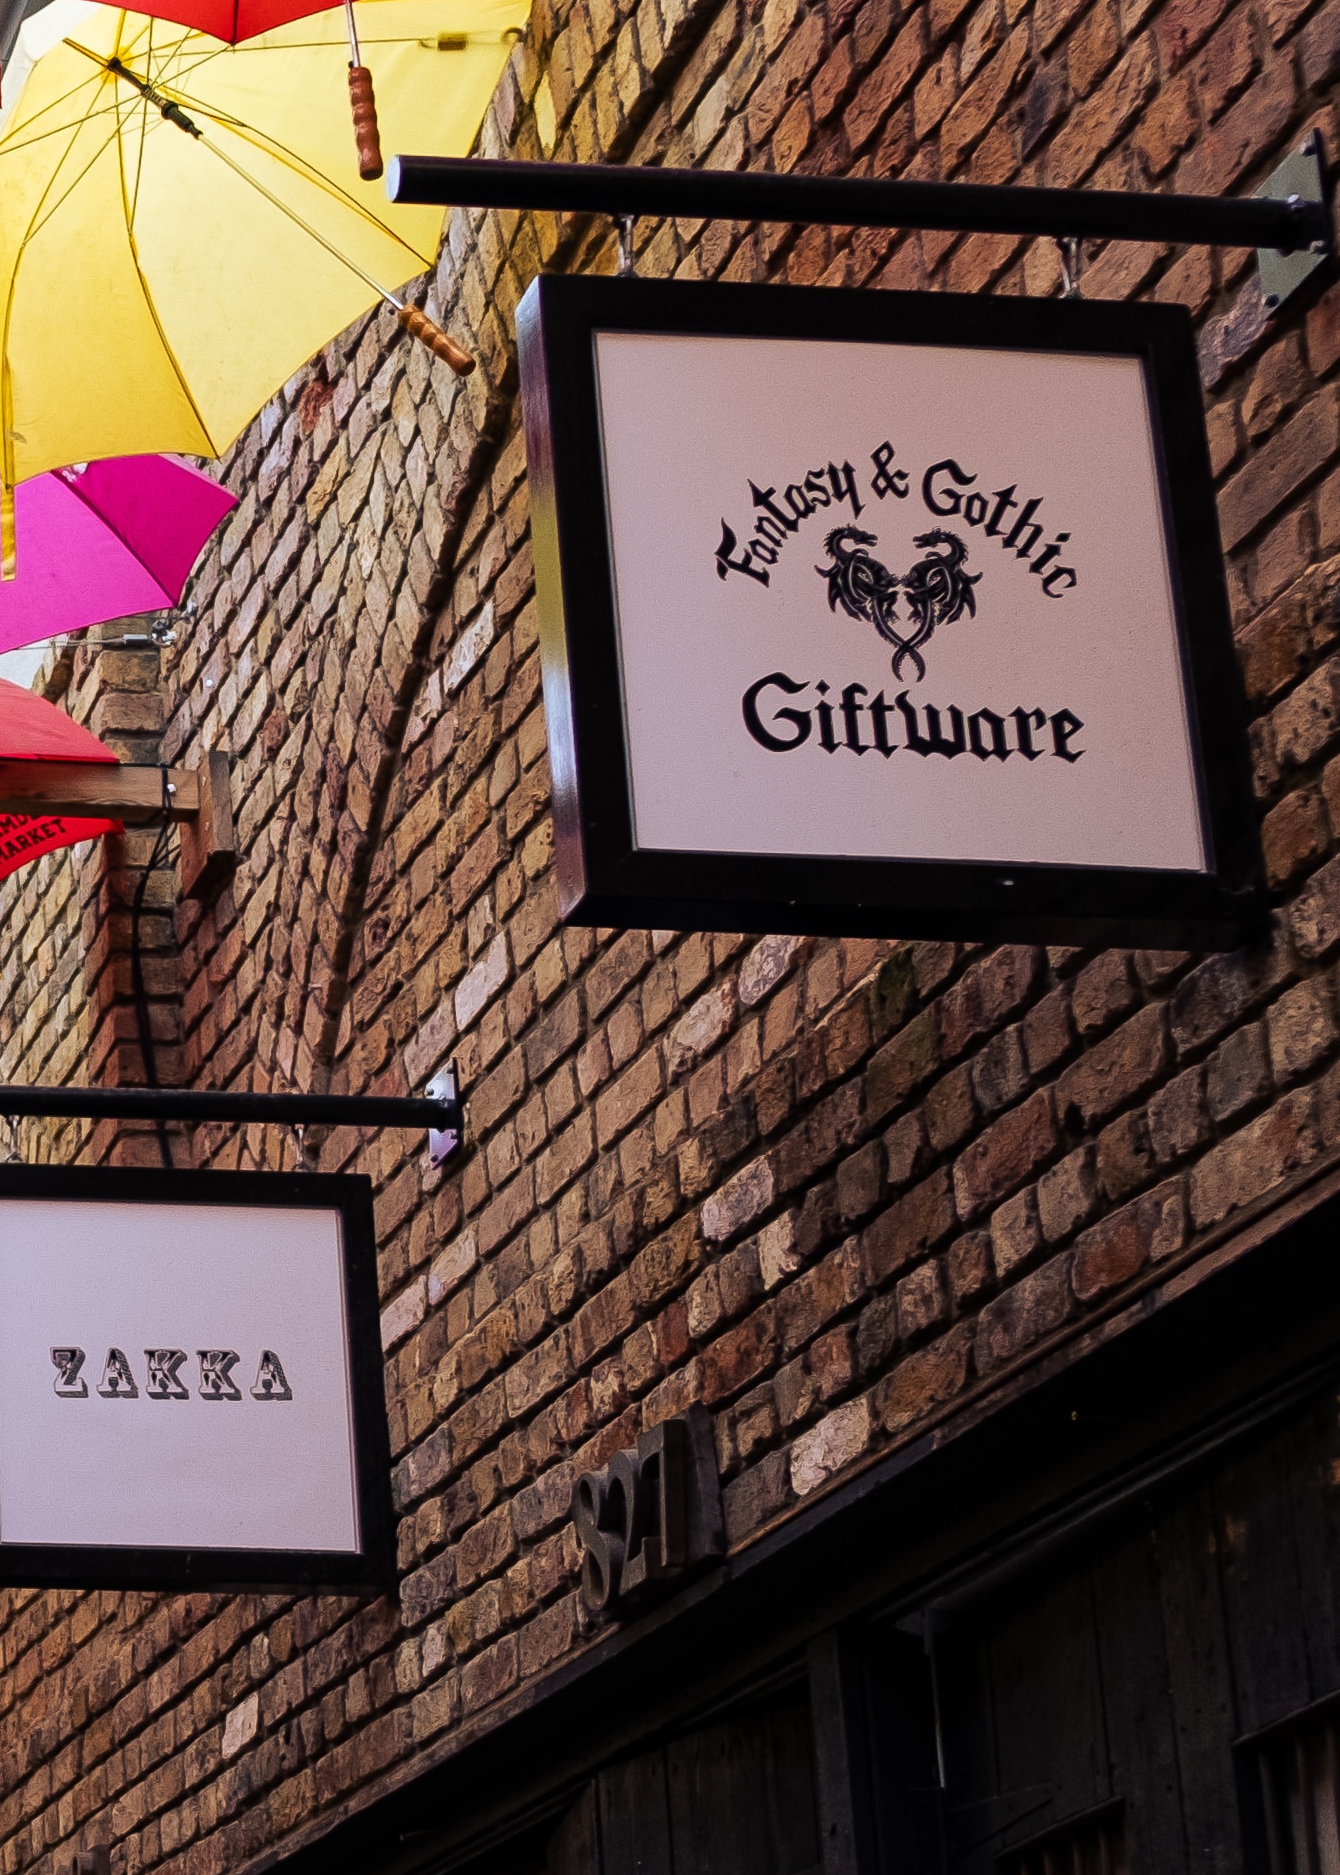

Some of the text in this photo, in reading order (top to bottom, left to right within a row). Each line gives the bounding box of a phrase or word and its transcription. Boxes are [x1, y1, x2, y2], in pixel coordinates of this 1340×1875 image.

[716, 441, 1077, 600] Fantasy & Gothic
[742, 672, 1086, 764] Giftware
[50, 1347, 292, 1401] ZAKKA
